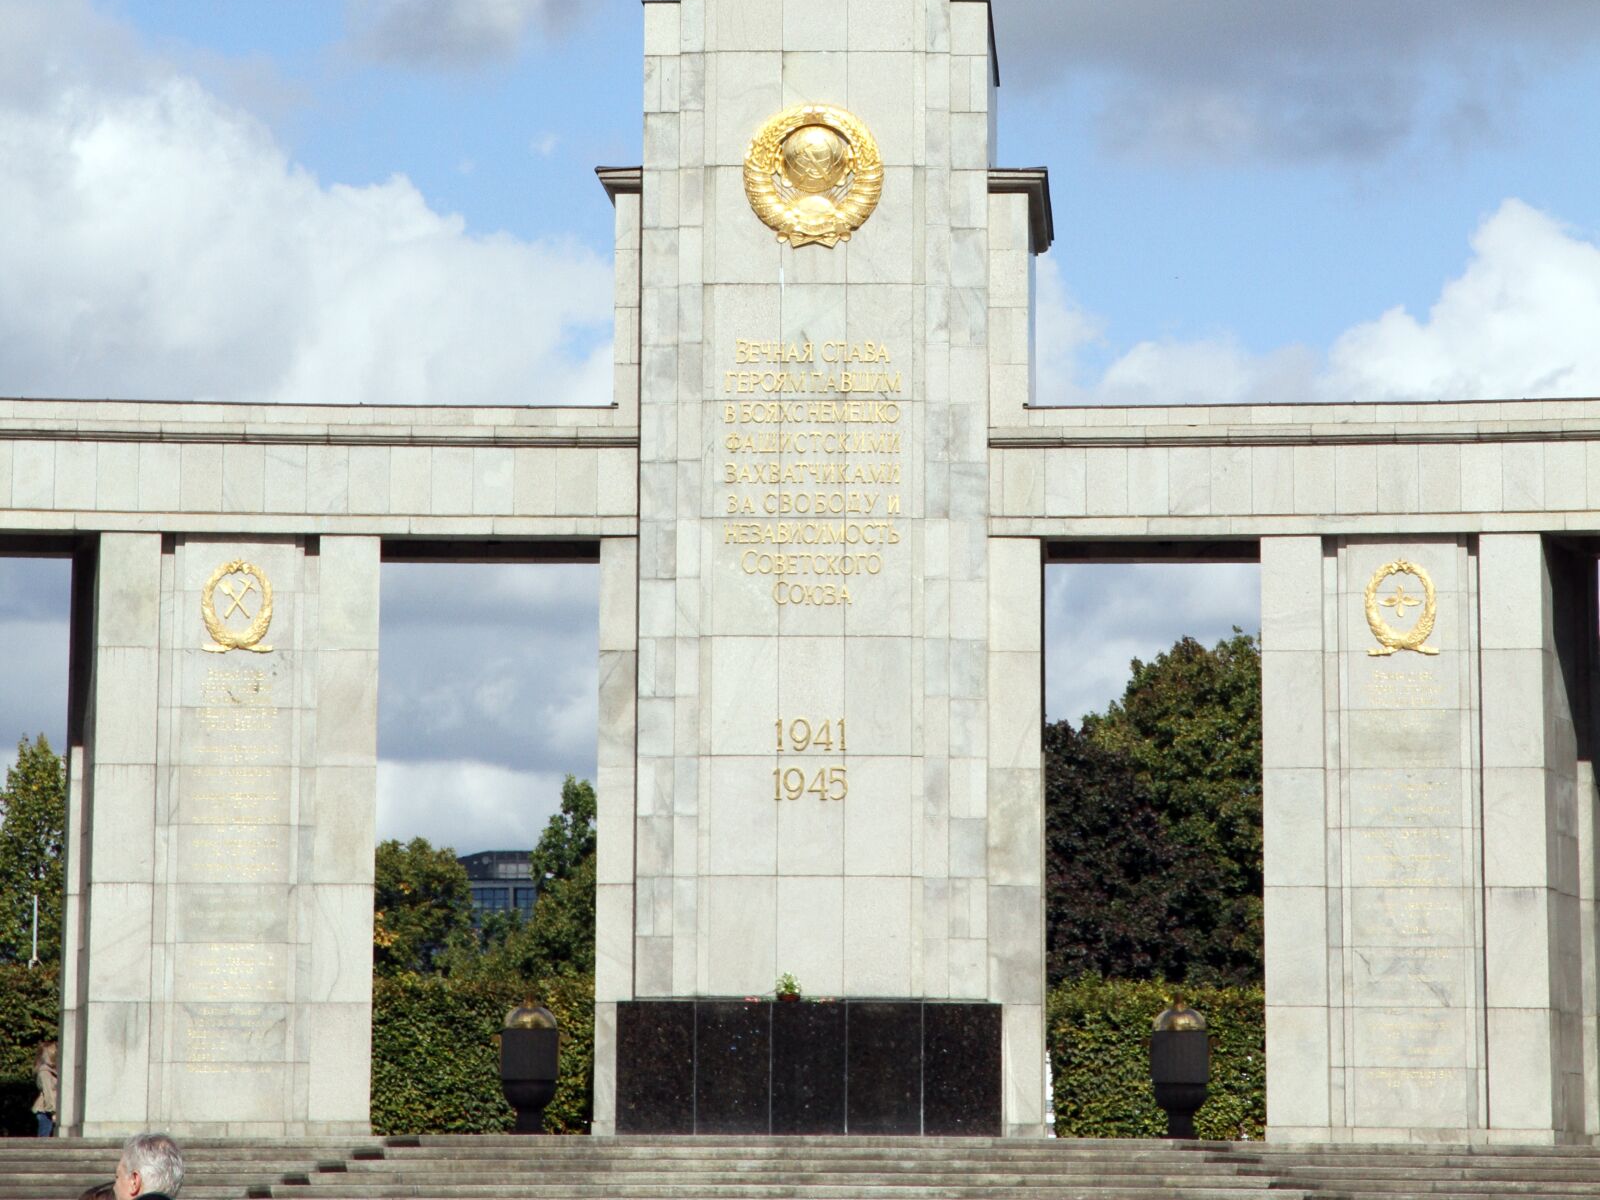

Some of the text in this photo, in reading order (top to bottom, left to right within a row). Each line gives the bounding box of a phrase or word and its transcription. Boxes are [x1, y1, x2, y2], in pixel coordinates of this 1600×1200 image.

[736, 338, 891, 363] ВЕЧНАЯ СЛАВА
[724, 371, 902, 393] ГЕРОЯМ ПАВШИМ
[724, 403, 736, 424] В
[739, 402, 793, 424] БОЯХ
[793, 403, 804, 424] С
[724, 432, 901, 454] ФАШИСТСКИМИ
[724, 463, 900, 484] ЗАХВАТЧИКАМИ
[726, 492, 901, 514] ЗА СВОБОДУ И
[723, 522, 900, 544] НЕЗАВИСИМОСТЬ
[741, 550, 882, 575] СОВЕТСКОГО
[773, 581, 853, 606] СОЮЗА
[775, 716, 847, 752] 1941
[772, 765, 849, 801] 1945
